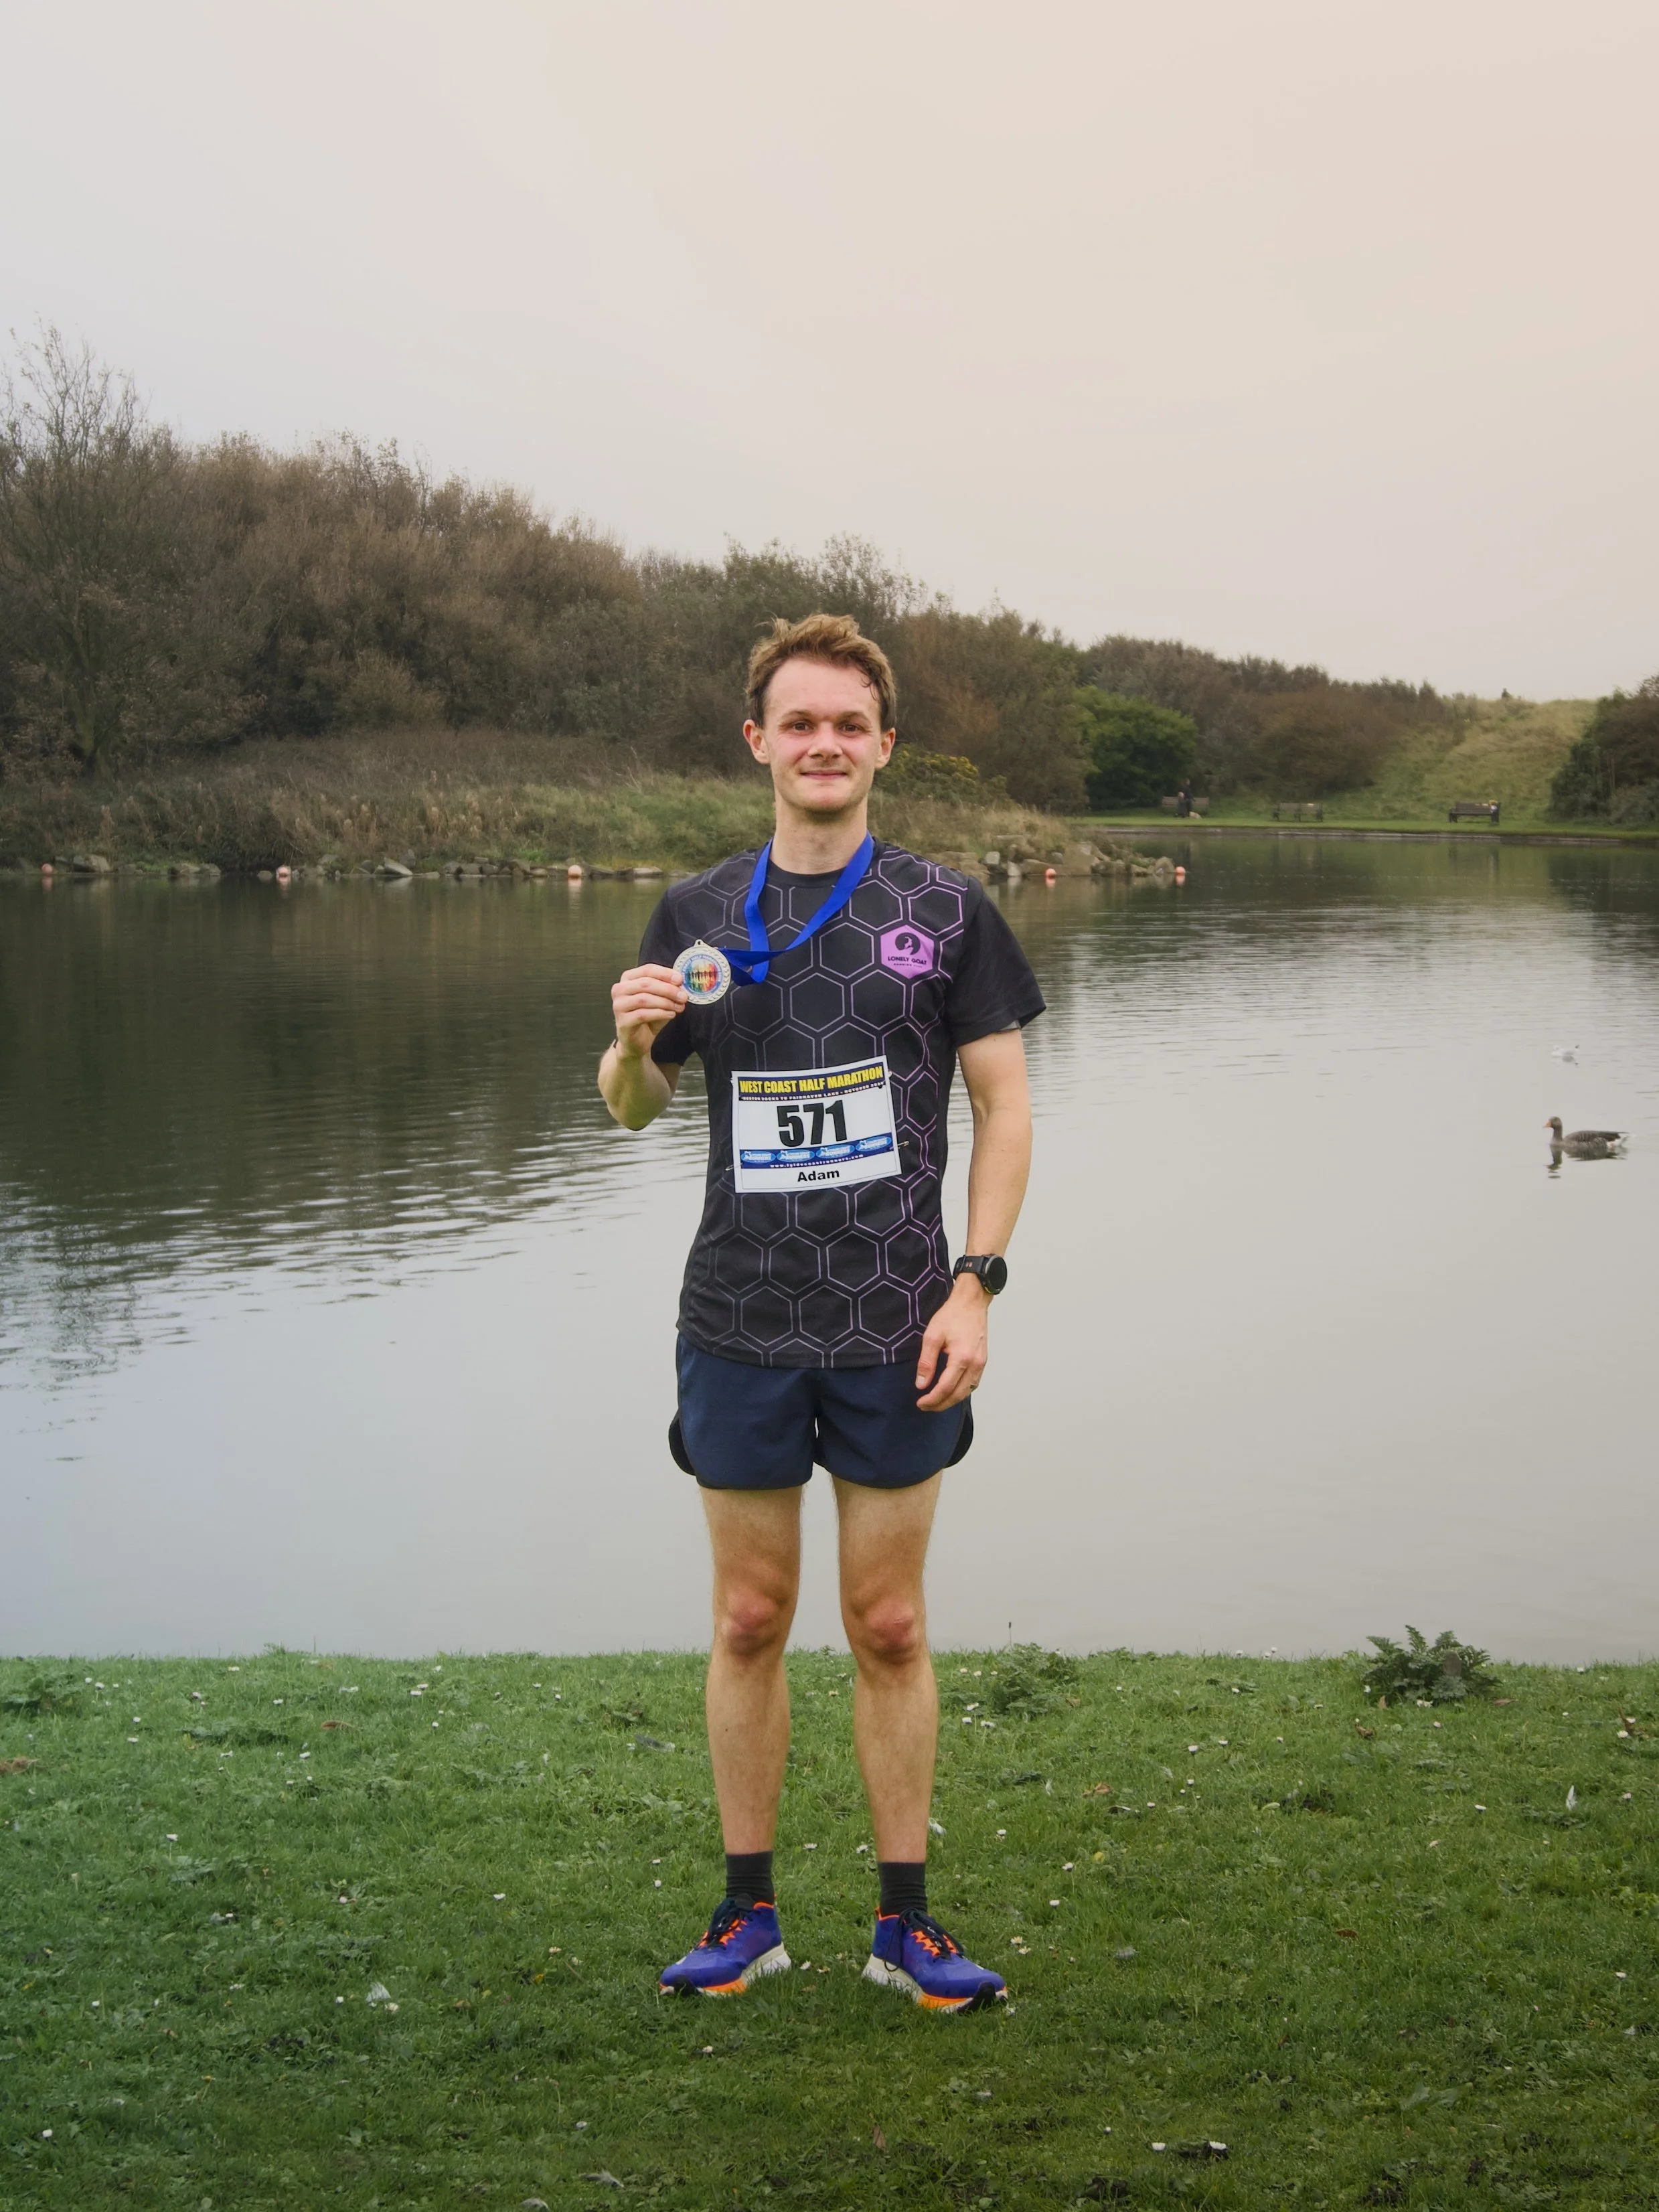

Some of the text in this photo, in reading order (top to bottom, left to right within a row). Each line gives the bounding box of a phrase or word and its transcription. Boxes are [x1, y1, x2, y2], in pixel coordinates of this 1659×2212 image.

[739, 1066, 884, 1093] WEST COAST HALF MARATHON
[777, 1100, 847, 1147] 571
[797, 1170, 840, 1182] Adam
